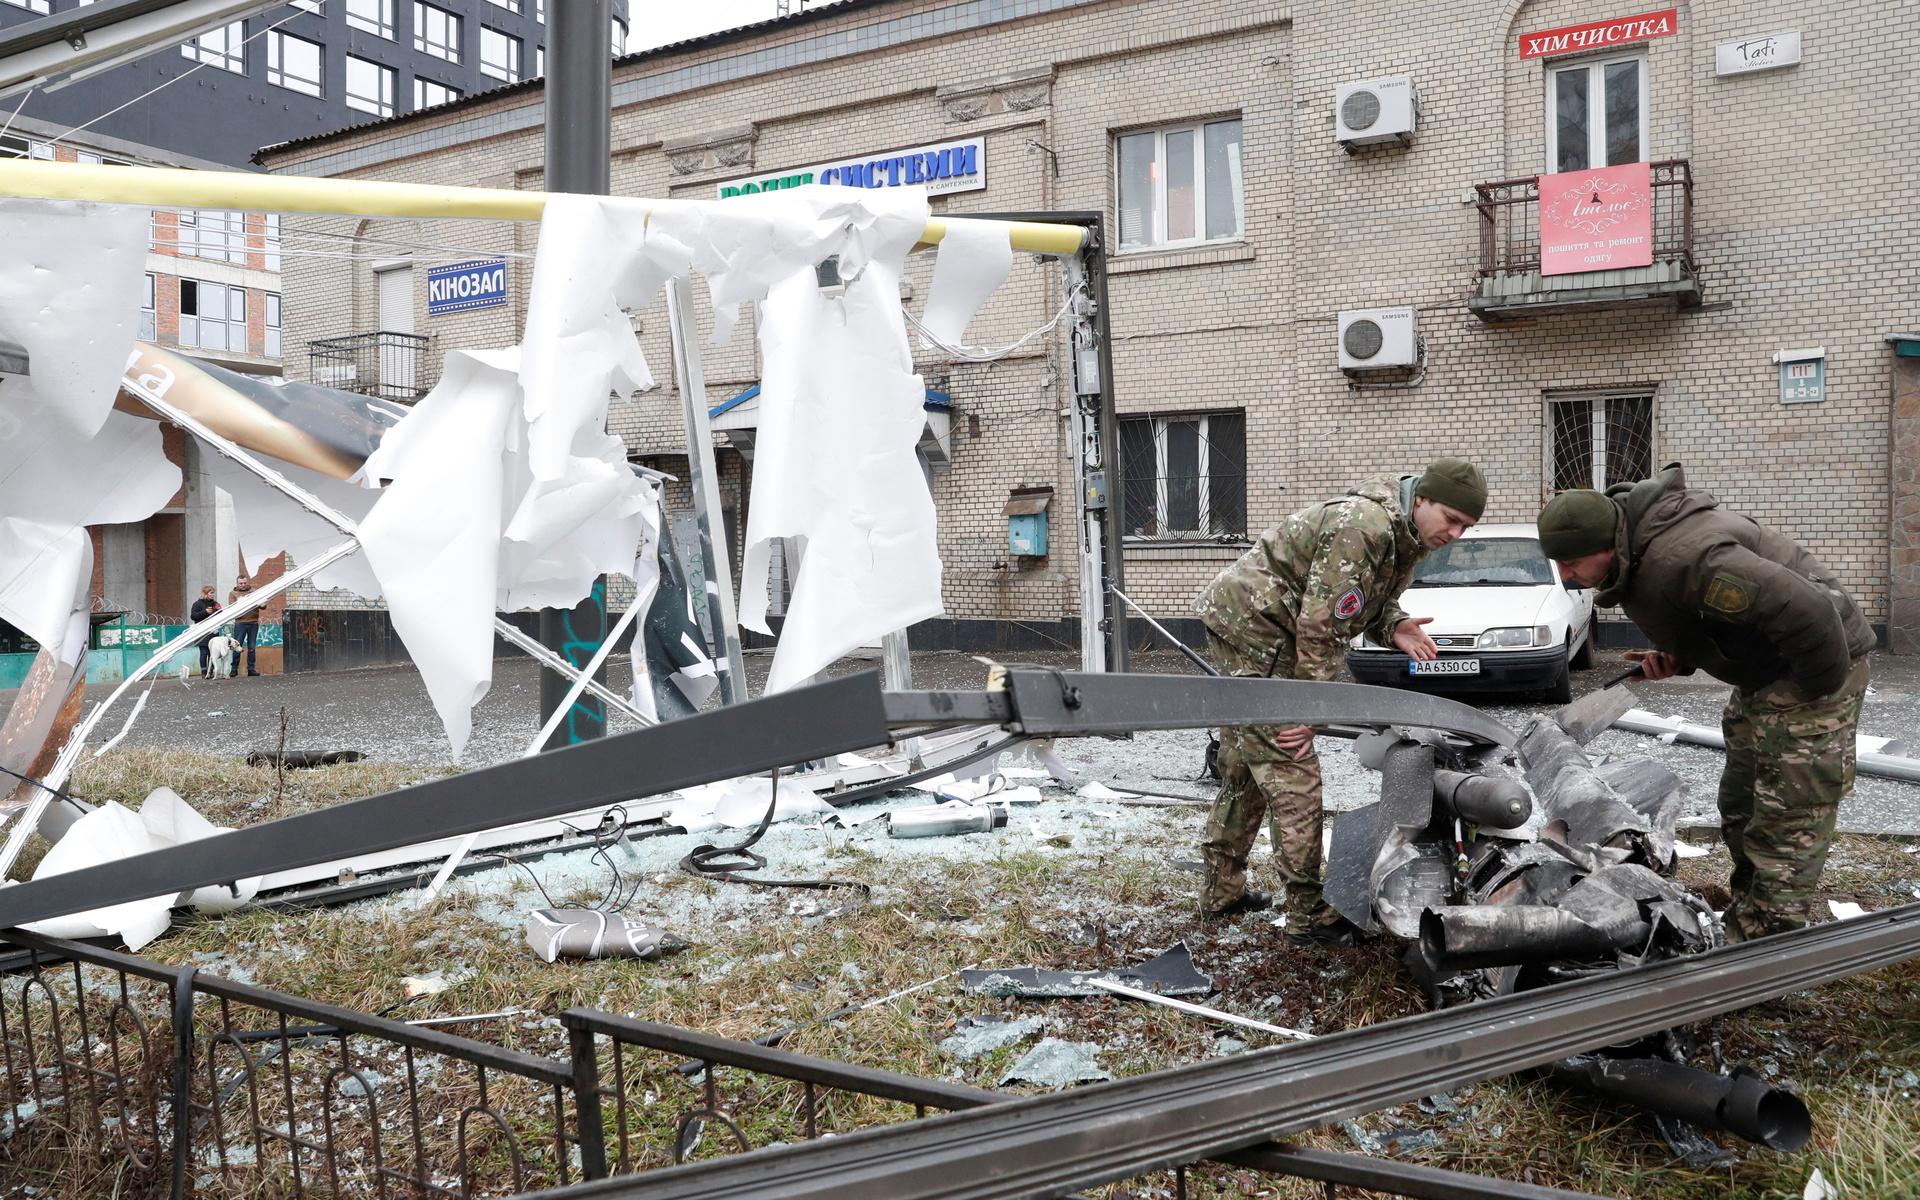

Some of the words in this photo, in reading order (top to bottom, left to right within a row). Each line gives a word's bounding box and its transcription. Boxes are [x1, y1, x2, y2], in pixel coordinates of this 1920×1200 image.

[1526, 16, 1670, 56] ХІМЧИСТКА
[1379, 80, 1407, 90] SAMSUNG
[820, 144, 978, 189] СИСТЕМИ
[935, 178, 979, 190] САНТЕХНІКА
[1548, 242, 1590, 254] пошиття
[1593, 240, 1605, 249] та
[1608, 236, 1644, 249] ремонт
[1583, 253, 1613, 265] одягу
[429, 269, 505, 302] КІНОЗАЛ
[1381, 313, 1409, 321] SAMSUNG
[1416, 662, 1432, 673] AA
[1433, 661, 1460, 672] 6350
[1461, 661, 1478, 672] CC
